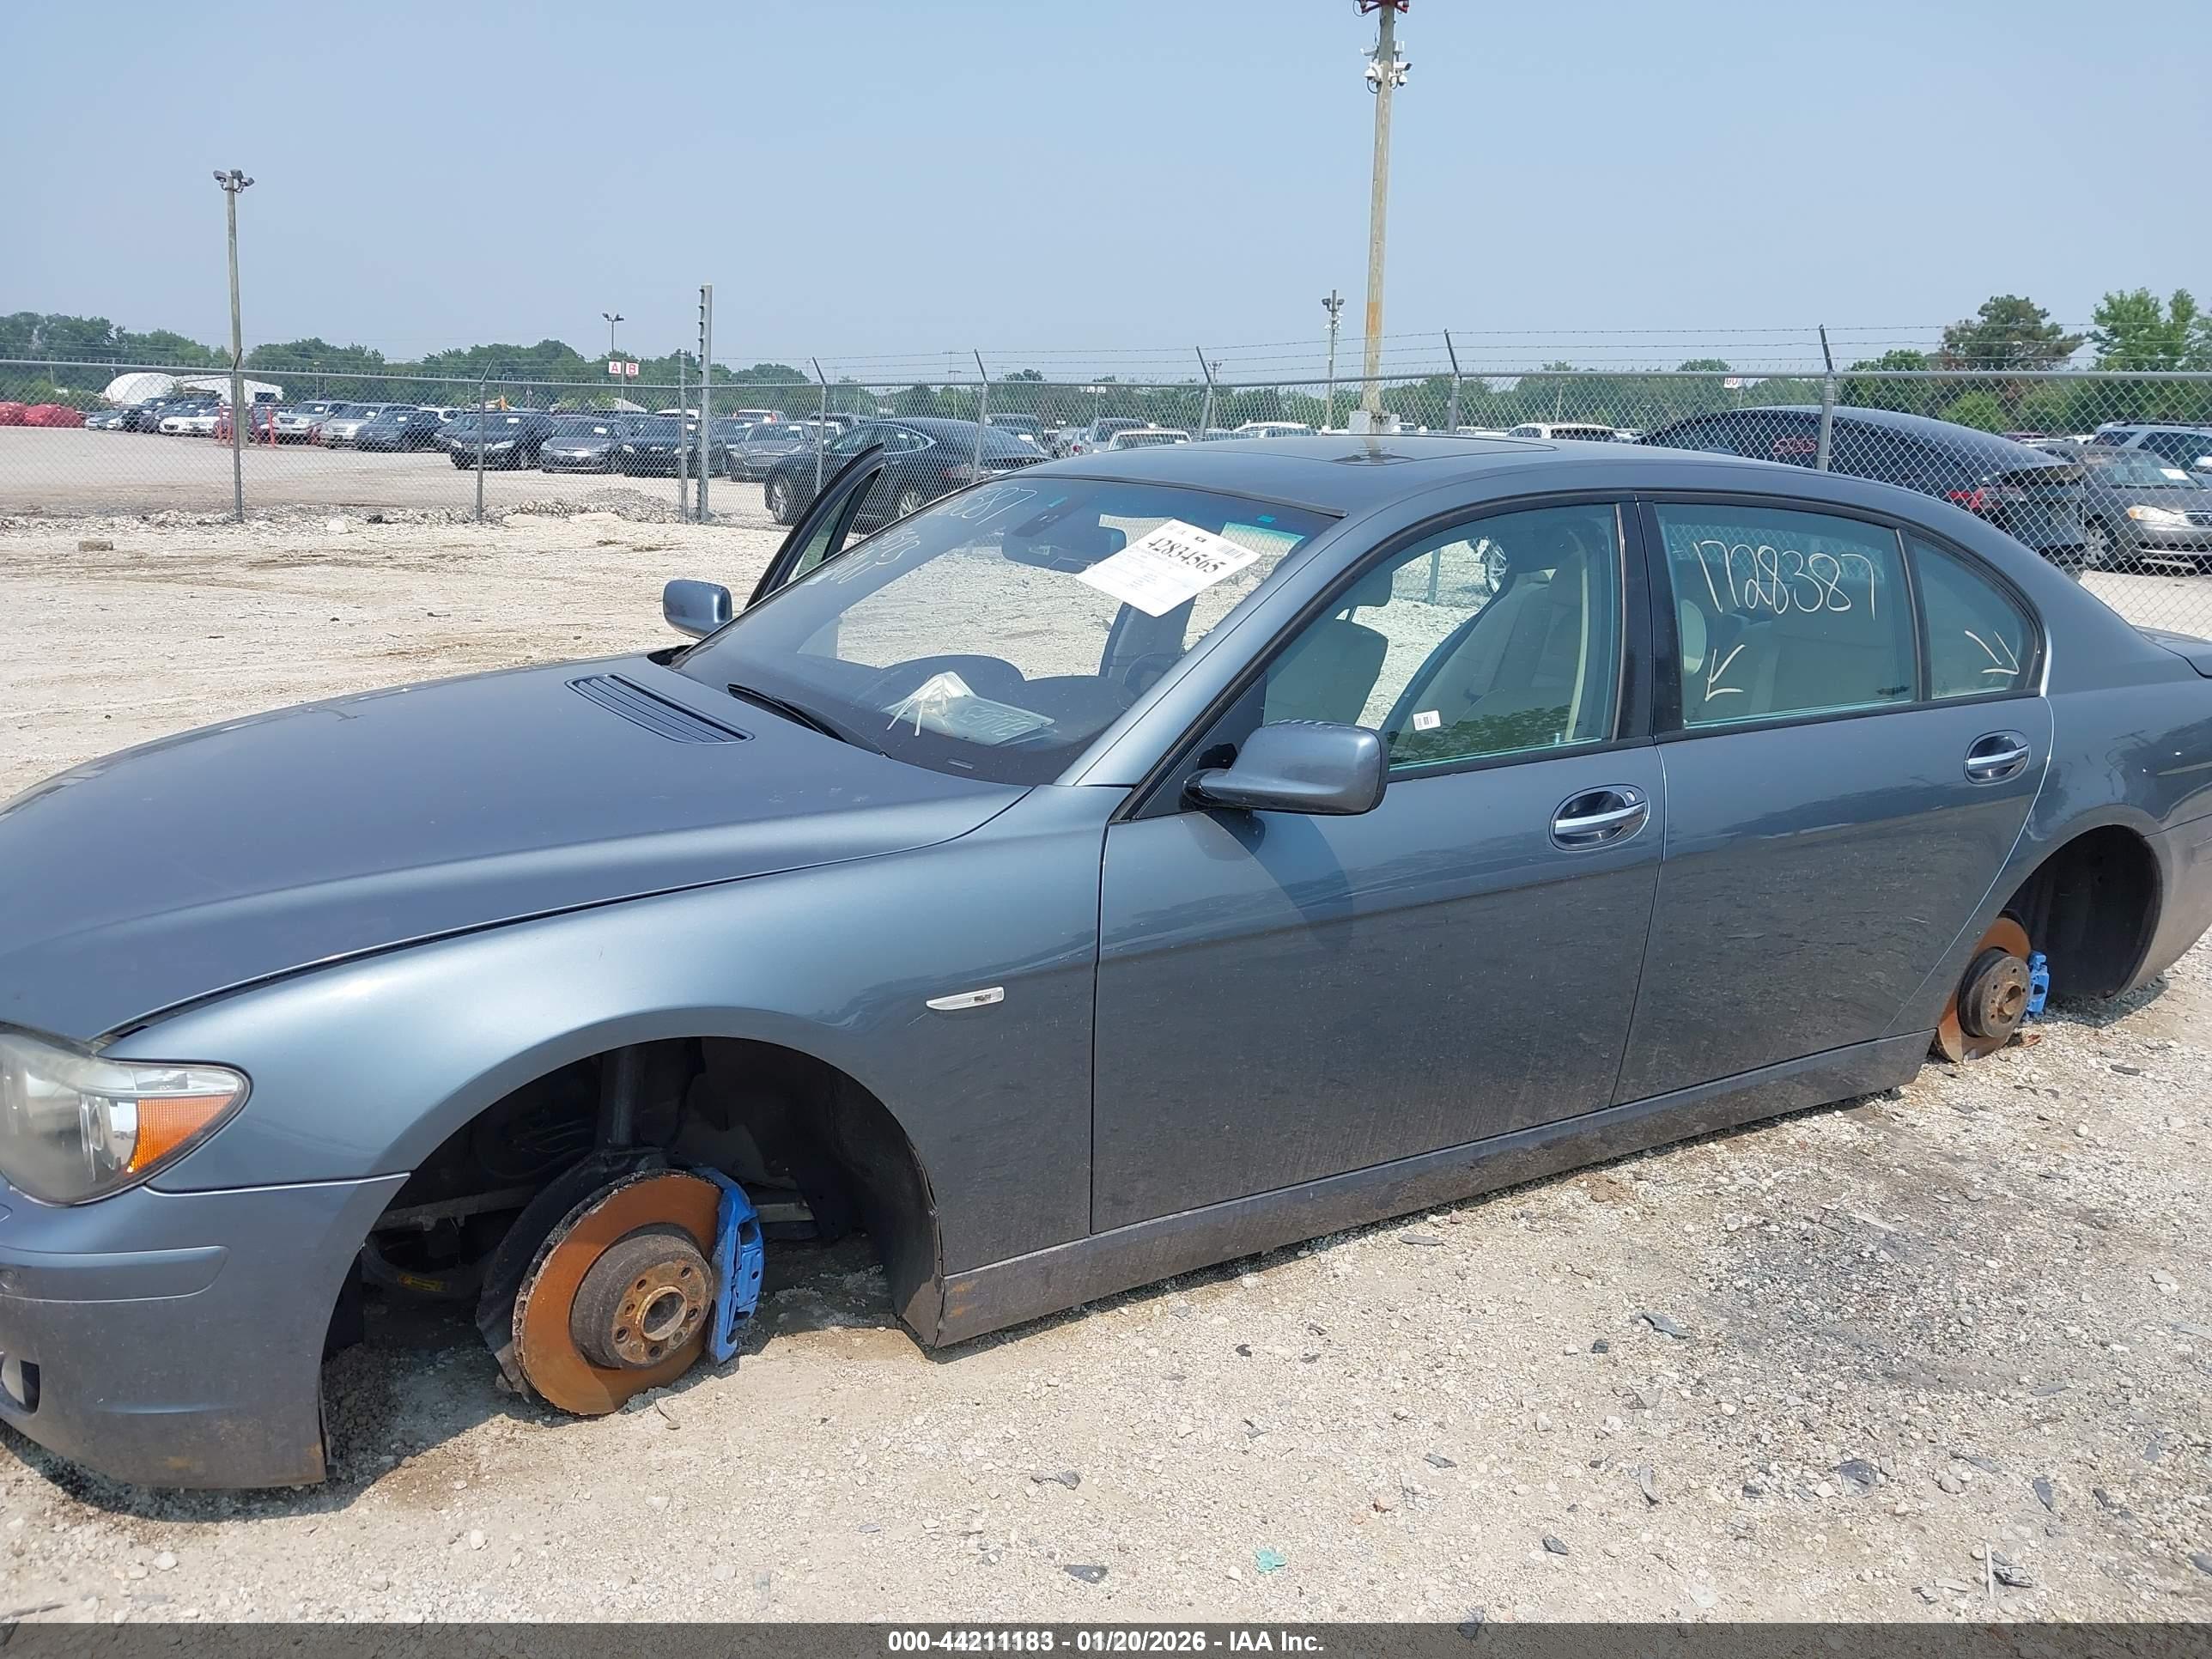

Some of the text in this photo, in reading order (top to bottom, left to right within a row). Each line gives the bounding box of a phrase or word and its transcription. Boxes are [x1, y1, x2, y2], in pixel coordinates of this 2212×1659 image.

[611, 362, 619, 373] A
[629, 363, 636, 374] B
[1147, 538, 1227, 574] 42834565
[1693, 540, 1876, 621] 1728387
